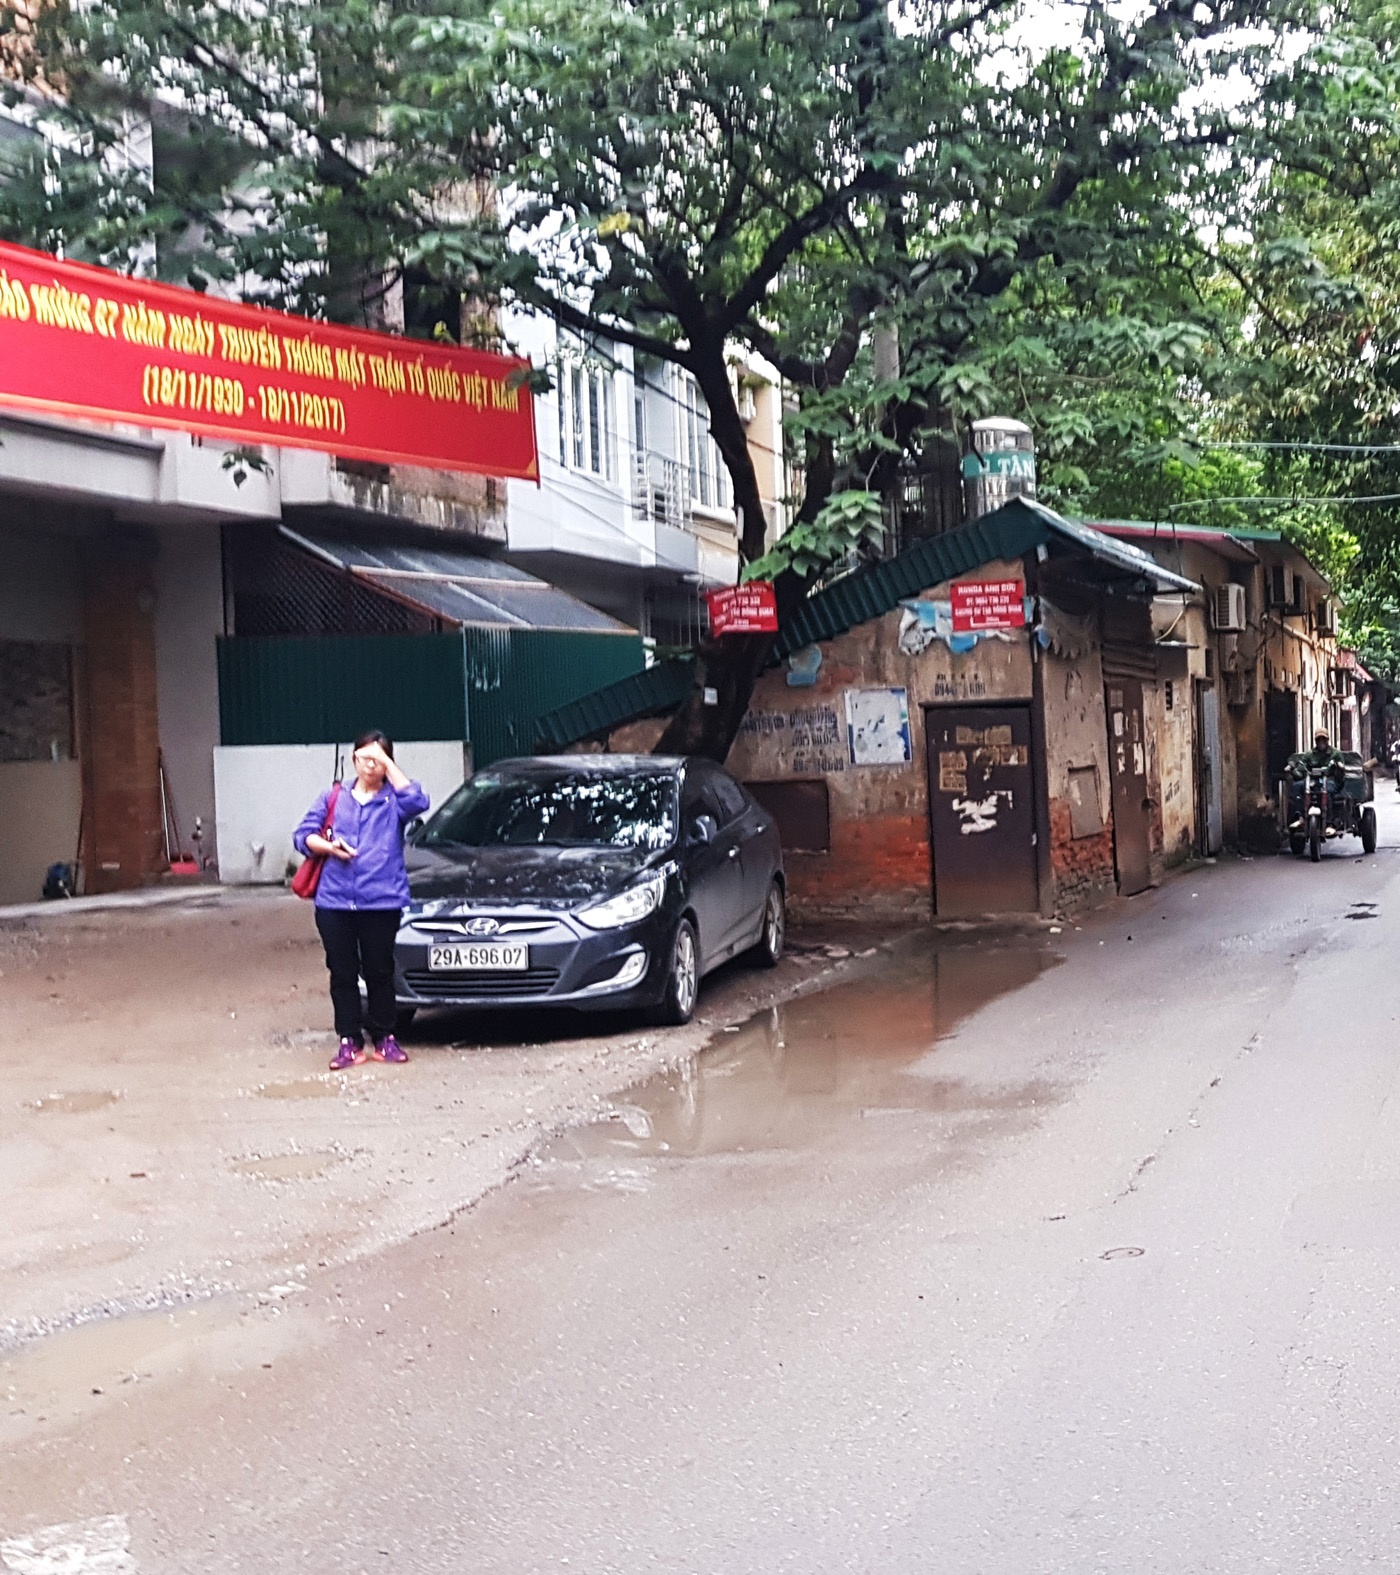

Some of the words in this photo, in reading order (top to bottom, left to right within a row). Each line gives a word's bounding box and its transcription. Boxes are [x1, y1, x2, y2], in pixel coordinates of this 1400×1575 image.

[30, 279, 94, 334] MỪNG
[122, 300, 166, 349] NĂM
[169, 311, 215, 358] NGÀY
[218, 322, 282, 370] TRUYỀN
[283, 331, 334, 380] THỐNG
[335, 344, 367, 390] MẶT
[369, 352, 405, 397] TRẬN
[427, 360, 460, 403] QUỐC
[463, 369, 487, 413] VIỆT
[143, 364, 244, 416] (18/11/1930
[258, 385, 345, 435] 18/11/2017)
